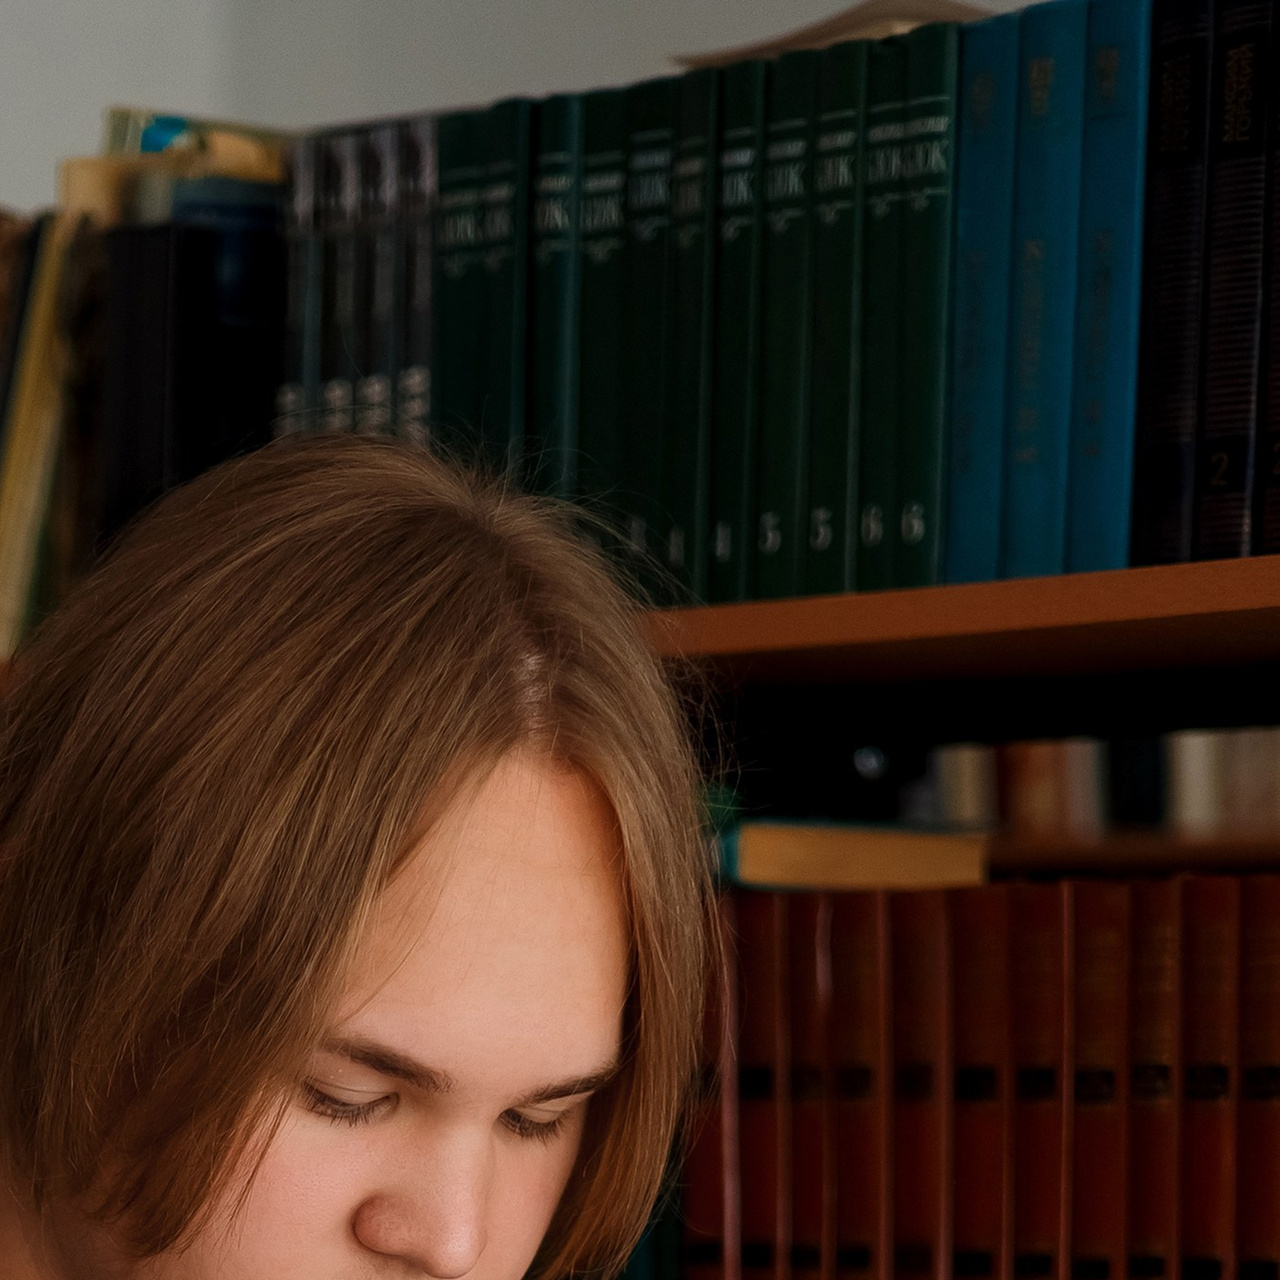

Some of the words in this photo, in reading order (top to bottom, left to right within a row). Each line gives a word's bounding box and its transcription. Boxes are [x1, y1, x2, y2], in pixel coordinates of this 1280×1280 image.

[1222, 47, 1238, 143] МАКСИМ
[1237, 42, 1255, 142] ГОРЬКИЙ
[1209, 450, 1230, 486] 2
[758, 511, 781, 556] 5
[809, 506, 833, 551] 5
[901, 500, 925, 545] 6
